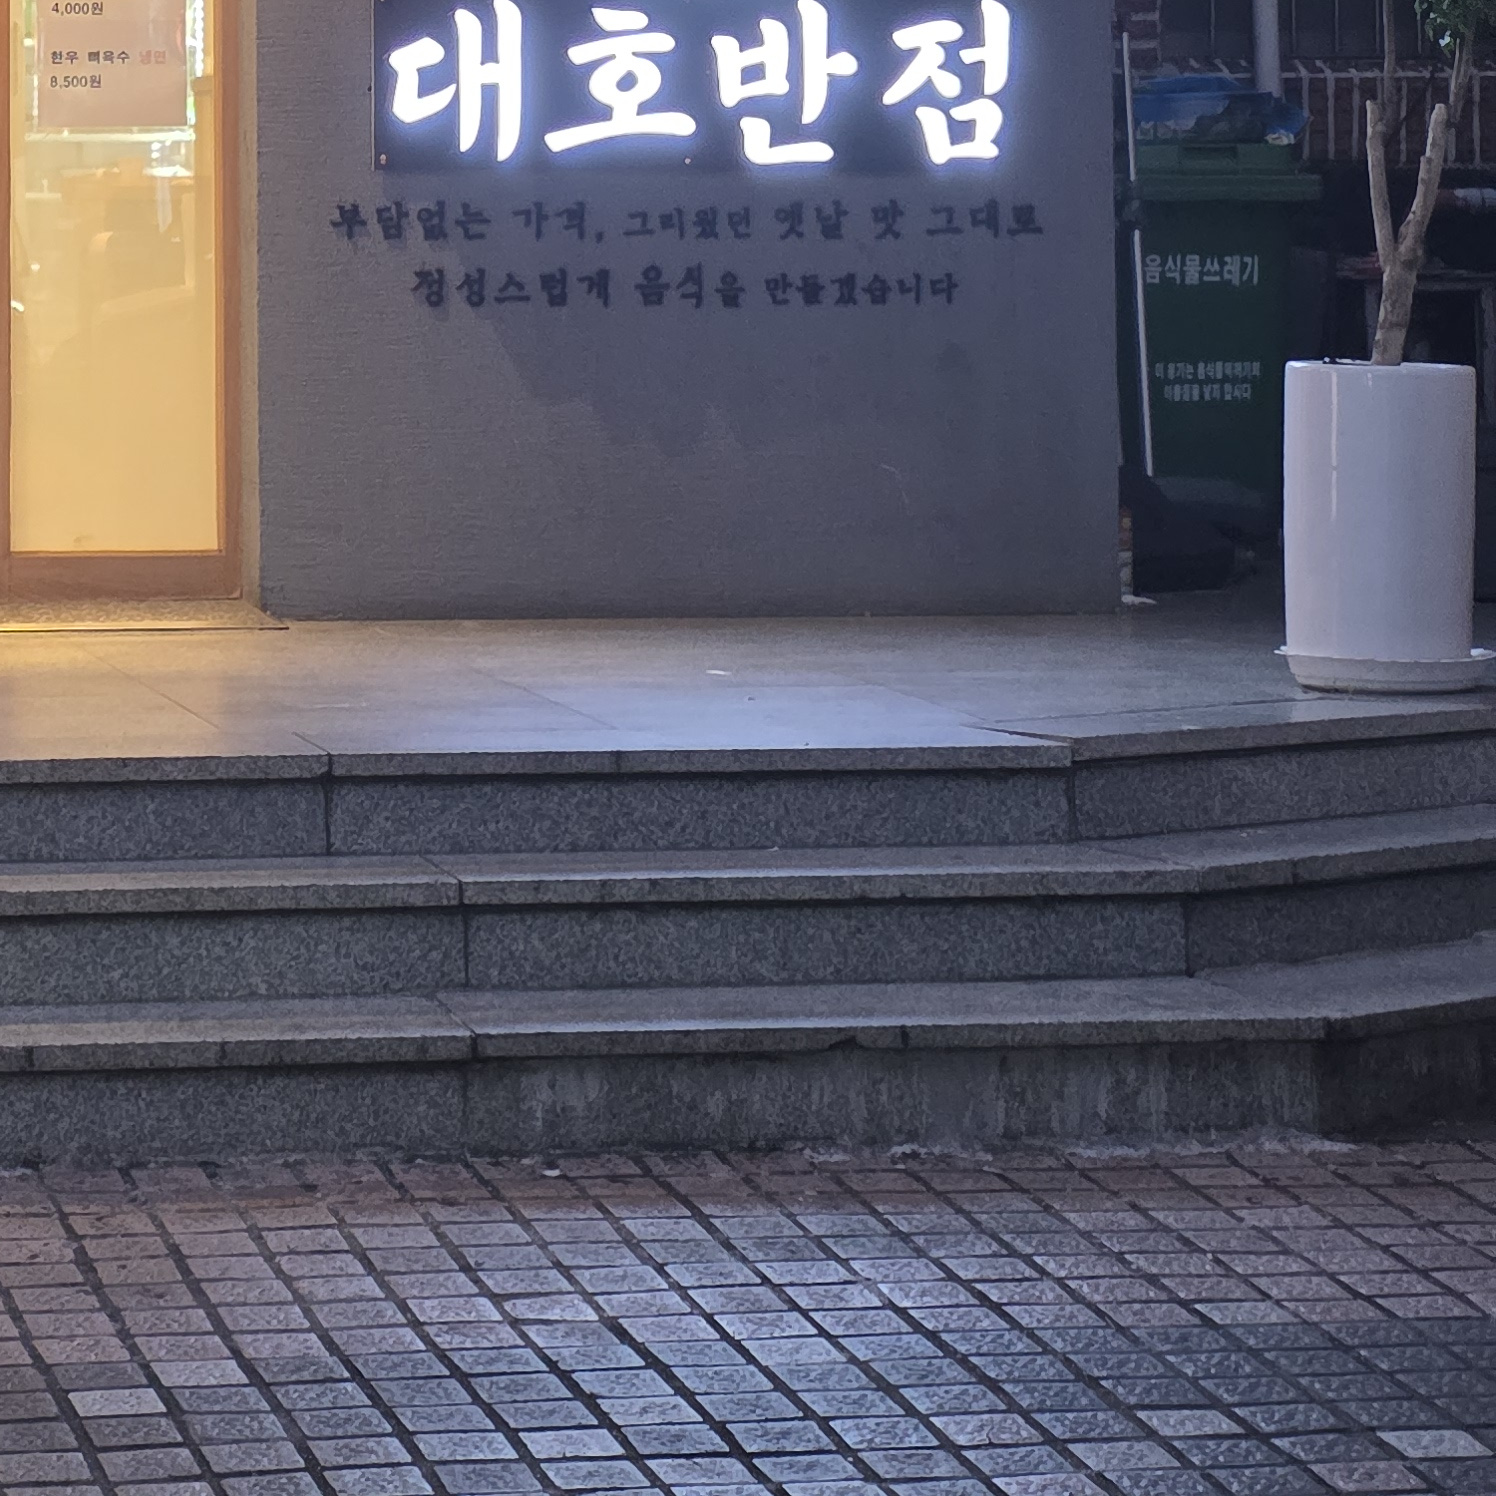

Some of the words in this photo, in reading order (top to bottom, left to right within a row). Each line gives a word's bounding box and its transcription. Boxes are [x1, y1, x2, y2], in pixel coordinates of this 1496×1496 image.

[51, 1, 104, 16] 4,000원
[329, 201, 492, 242] 부담없는
[773, 199, 850, 241] 옛날
[870, 199, 906, 241] 맛
[925, 199, 1045, 240] 그대로
[411, 266, 611, 308] 정성스럽게
[633, 262, 746, 309] 음식을
[1144, 253, 1259, 287] 음식물쓰레기
